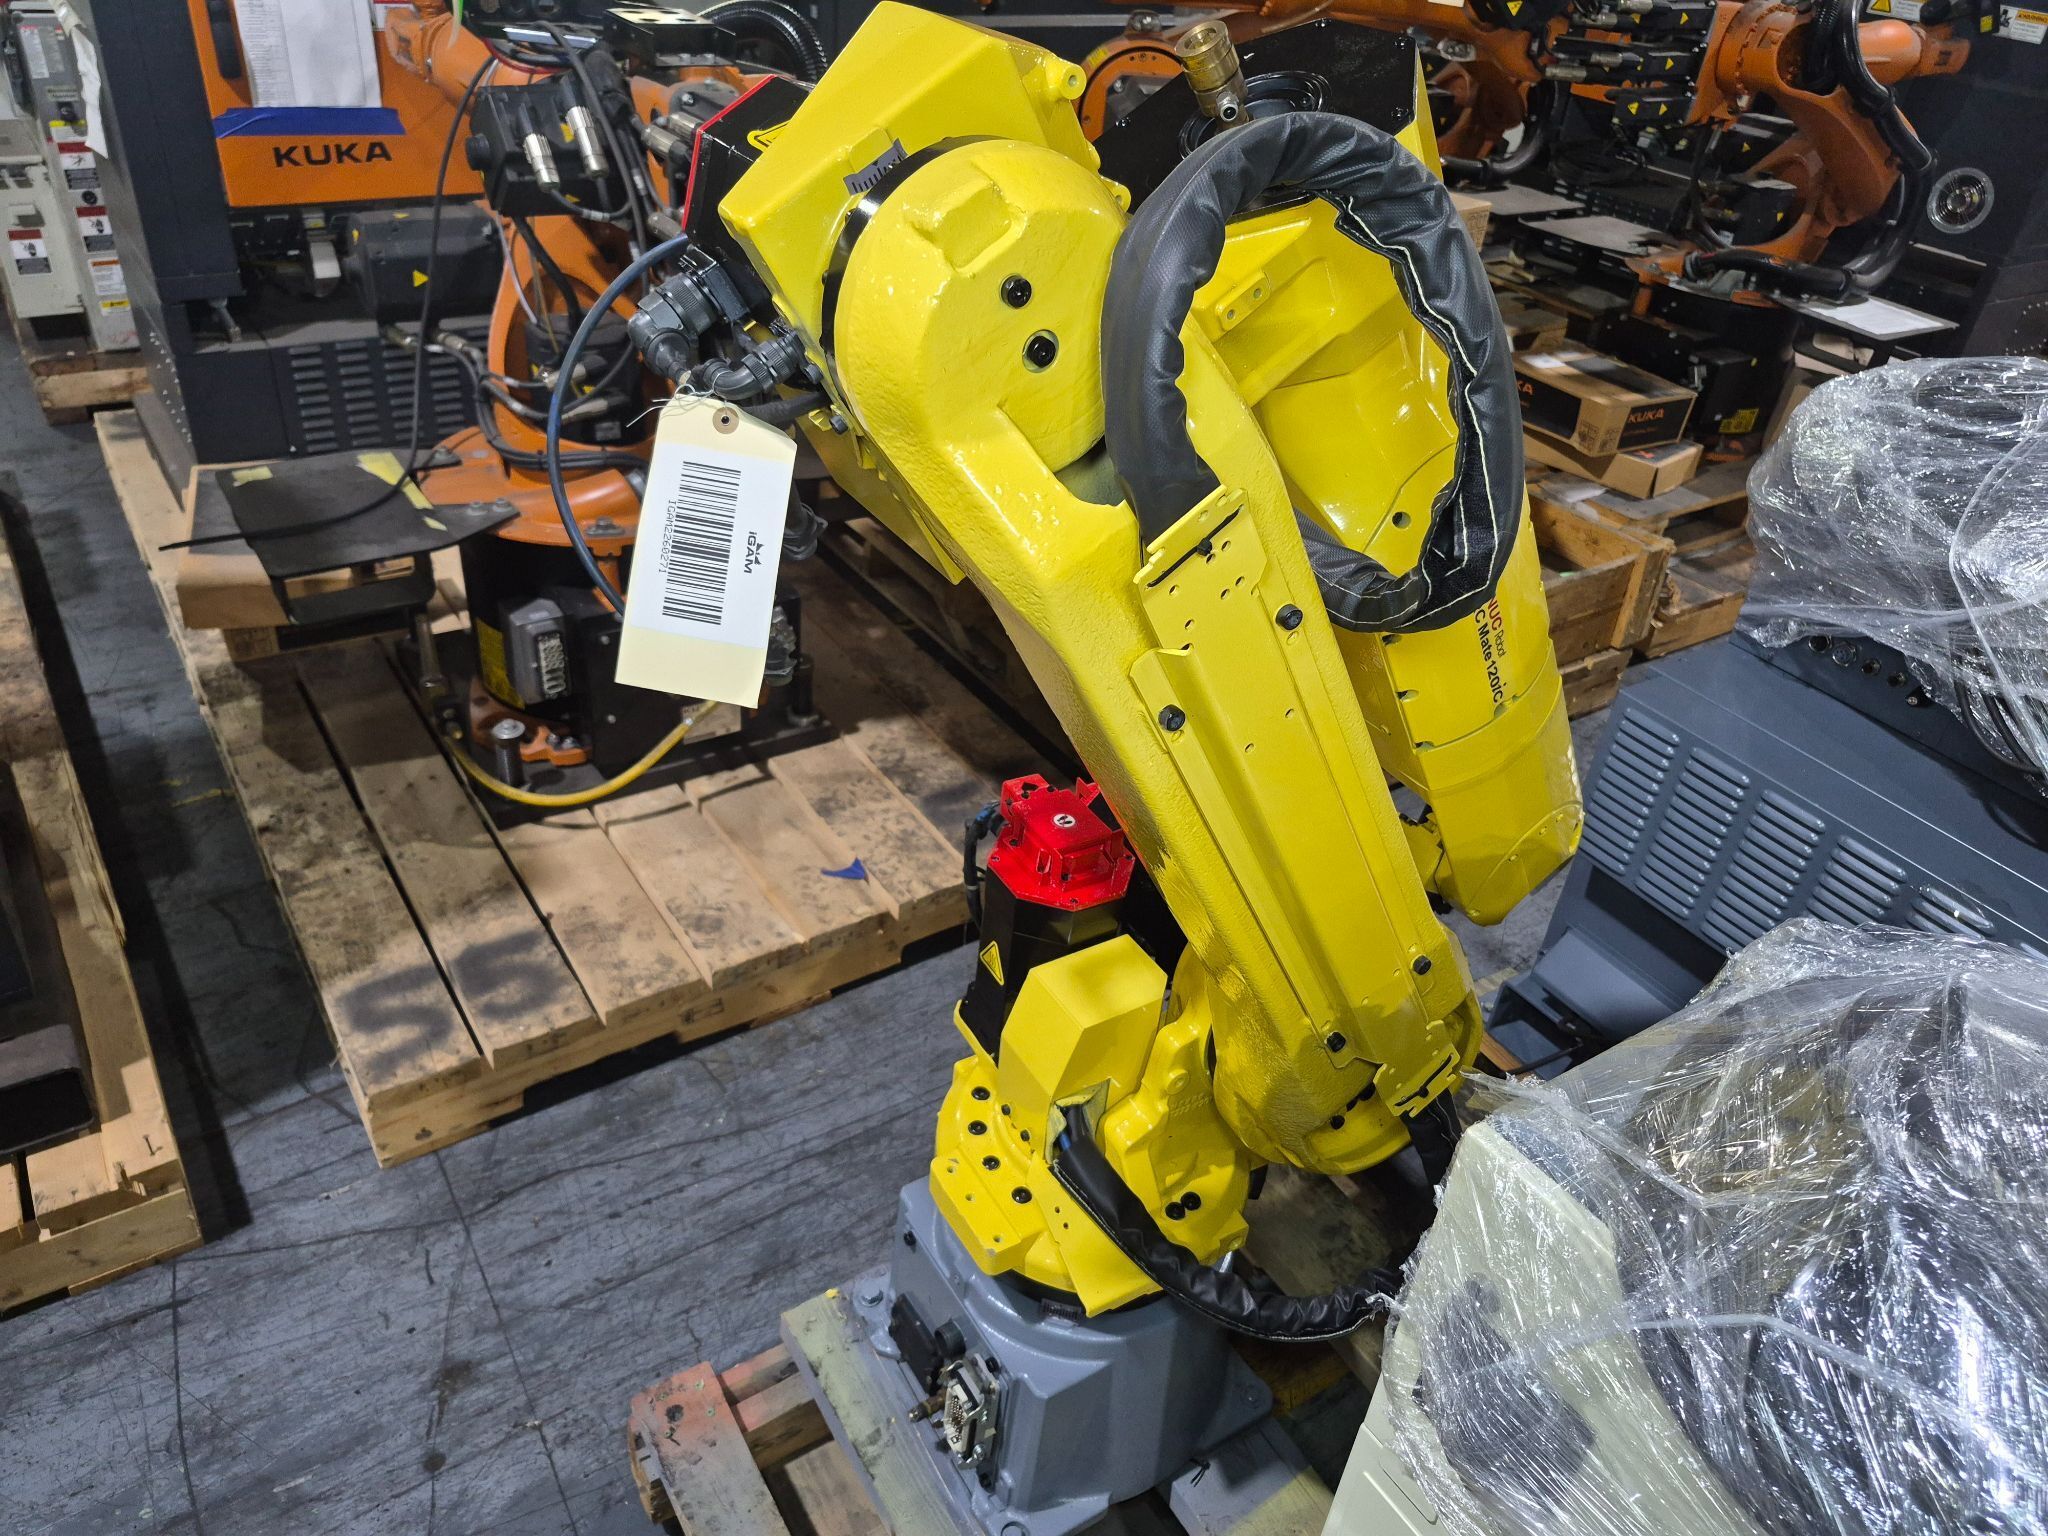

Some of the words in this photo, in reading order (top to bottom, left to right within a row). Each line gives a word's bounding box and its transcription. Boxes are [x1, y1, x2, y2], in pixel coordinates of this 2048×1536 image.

[272, 141, 393, 168] KUKA
[1628, 408, 1665, 424] KUKA
[658, 499, 677, 573] IGAM2260271
[744, 531, 758, 574] iGAM
[1478, 622, 1492, 662] Mate
